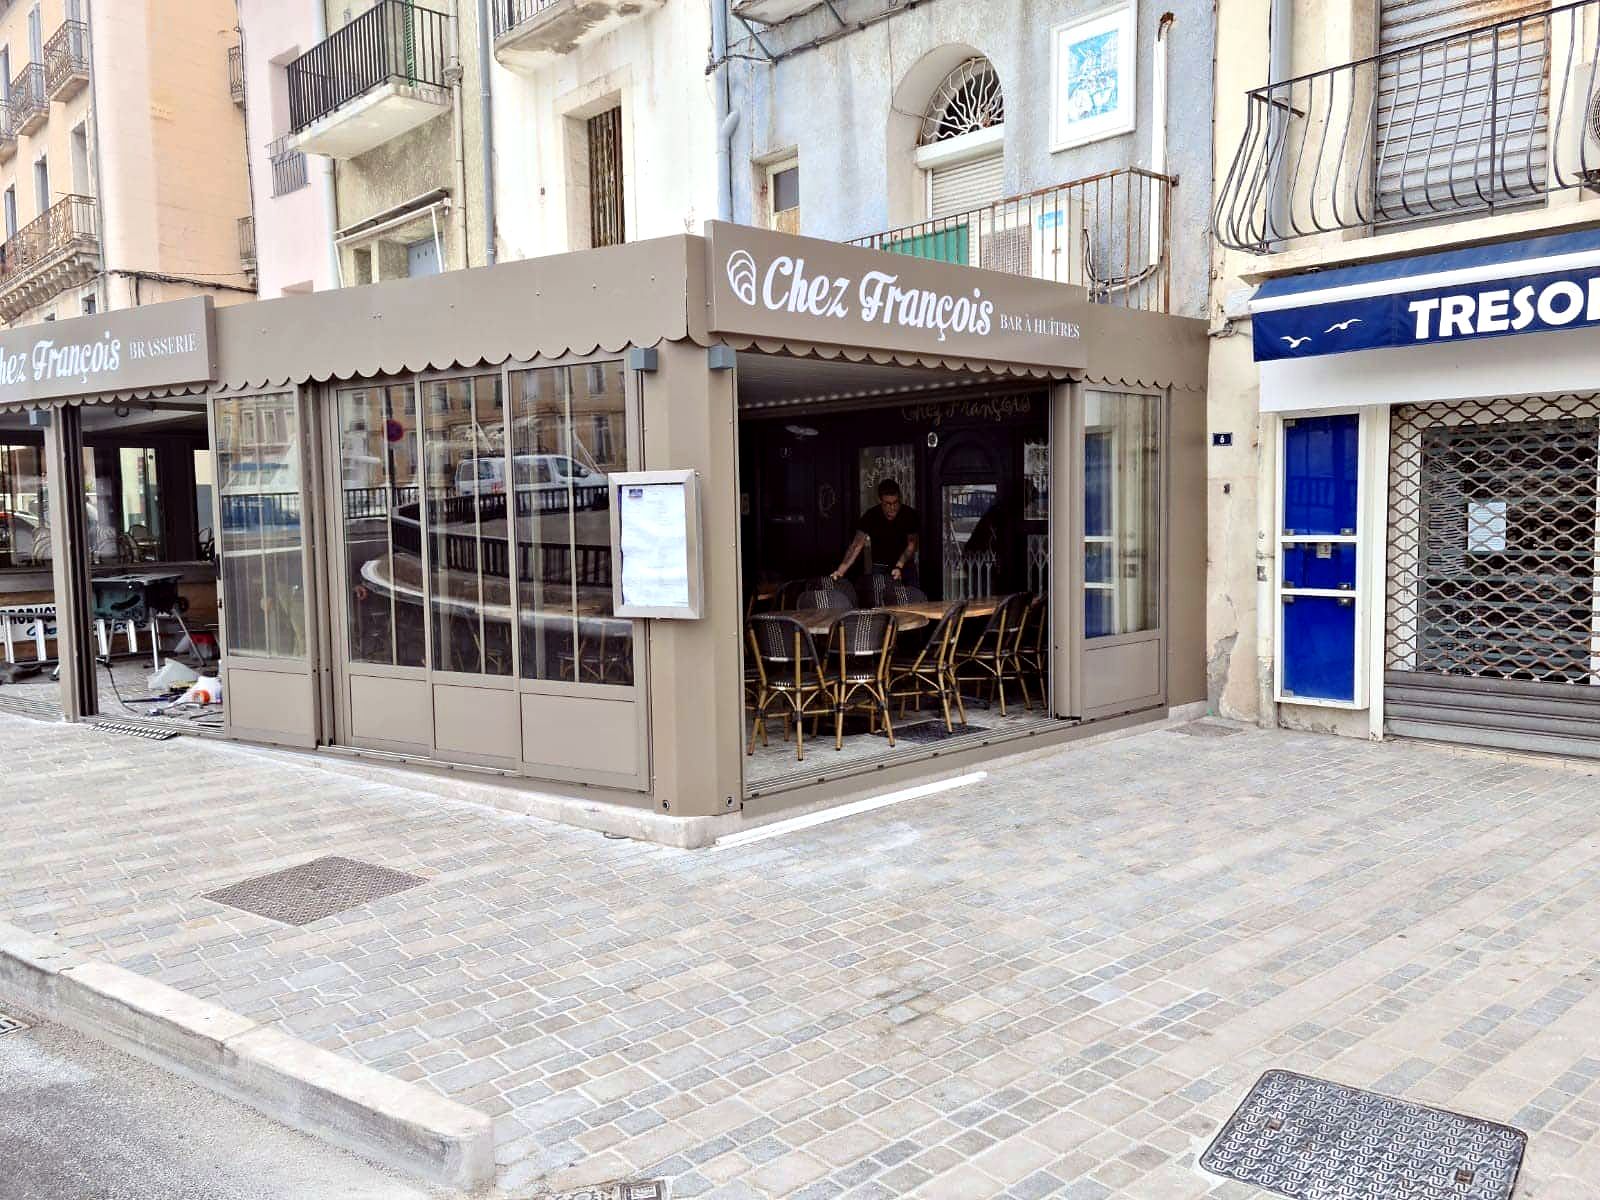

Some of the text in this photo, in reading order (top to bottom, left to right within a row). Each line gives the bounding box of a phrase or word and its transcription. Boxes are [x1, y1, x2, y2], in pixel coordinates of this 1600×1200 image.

[763, 256, 849, 317] Chez
[859, 271, 993, 340] François
[1000, 313, 1023, 332] BAR
[1034, 317, 1080, 338] HUÎTRES
[32, 330, 120, 384] François
[129, 334, 198, 359] BRASSERIE
[1219, 435, 1226, 444] 6
